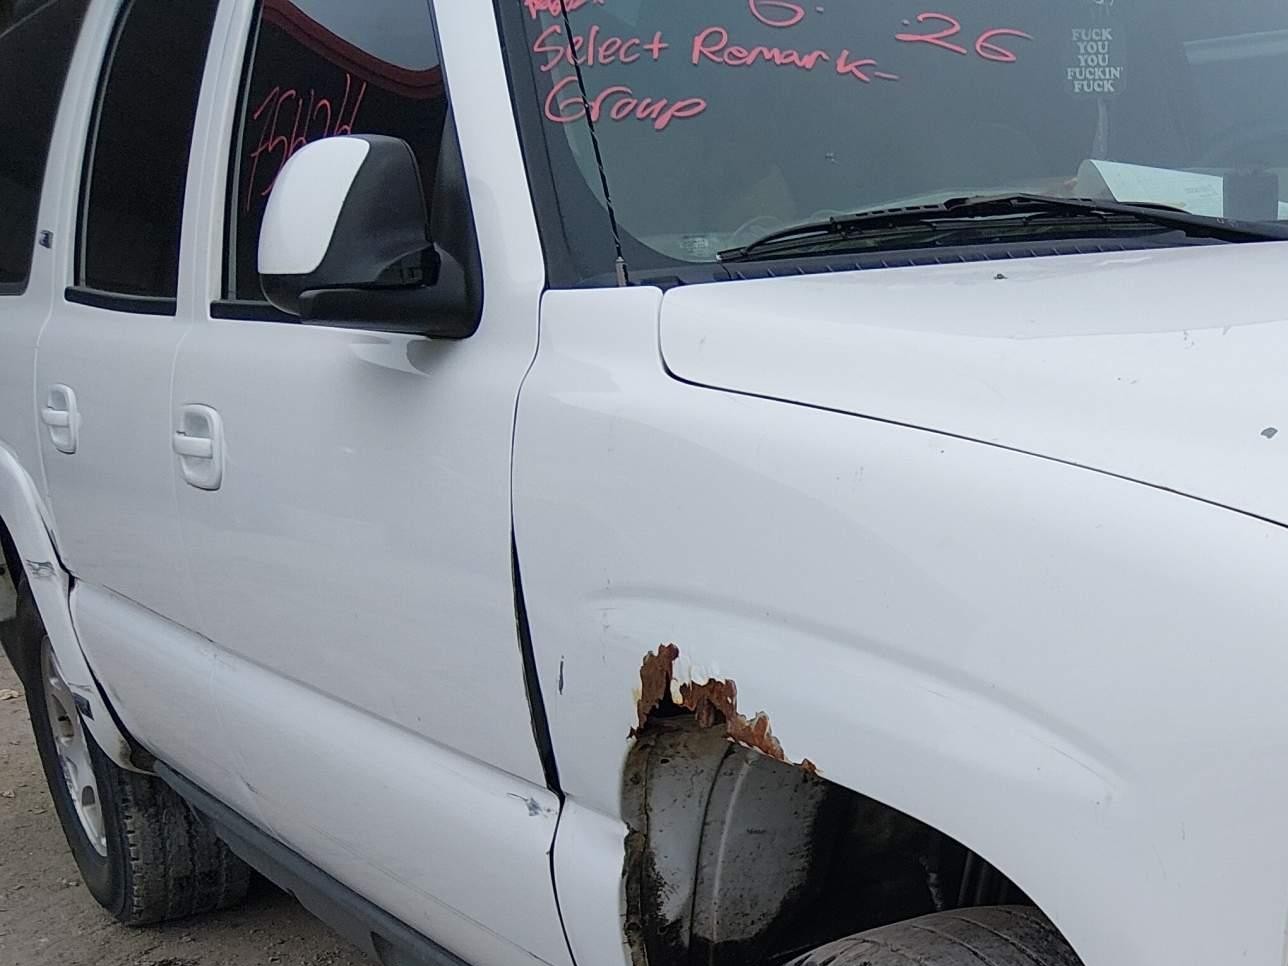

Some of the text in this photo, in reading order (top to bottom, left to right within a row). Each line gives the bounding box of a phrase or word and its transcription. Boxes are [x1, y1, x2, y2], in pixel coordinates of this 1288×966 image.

[1072, 28, 1113, 41] FUCK
[533, 24, 668, 71] Select
[1077, 41, 1109, 54] YOU
[1078, 54, 1109, 66] YOU
[1067, 66, 1124, 80] FUCKIN'
[1073, 80, 1115, 93] FUCK
[544, 76, 708, 130] Group
